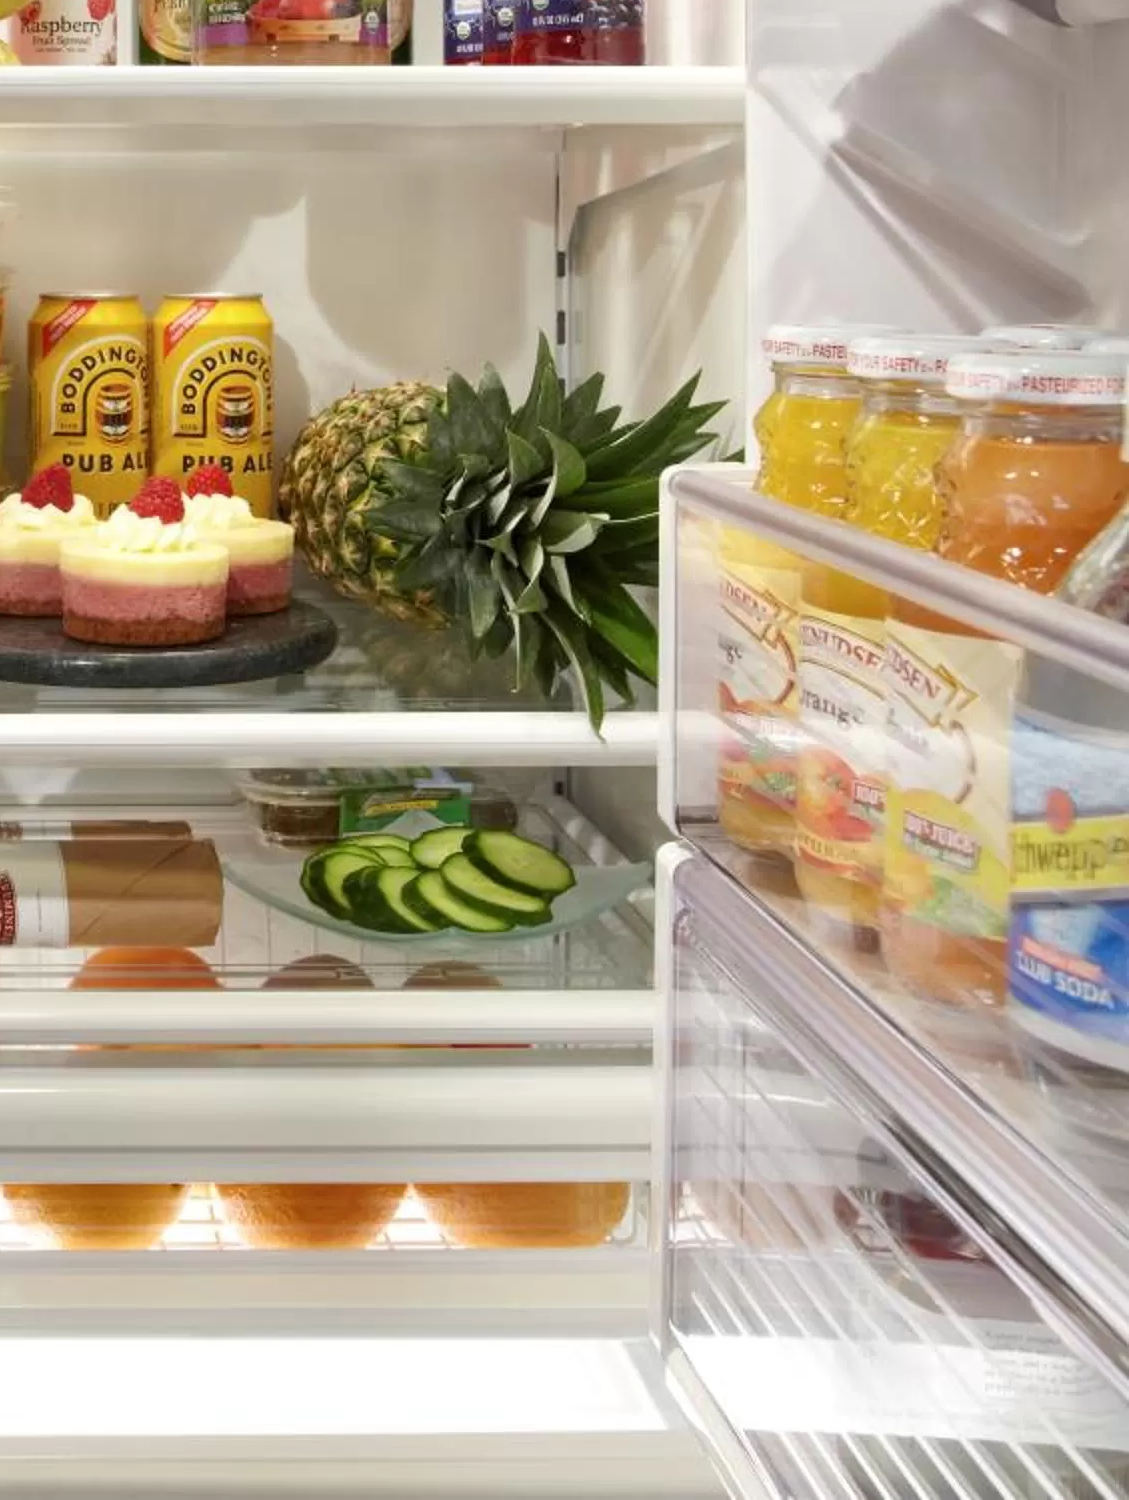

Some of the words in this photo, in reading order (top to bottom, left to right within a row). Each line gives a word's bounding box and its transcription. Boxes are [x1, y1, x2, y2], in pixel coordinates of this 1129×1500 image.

[21, 14, 103, 37] Raspberry
[882, 356, 921, 374] SAFETY
[62, 453, 113, 473] PUB
